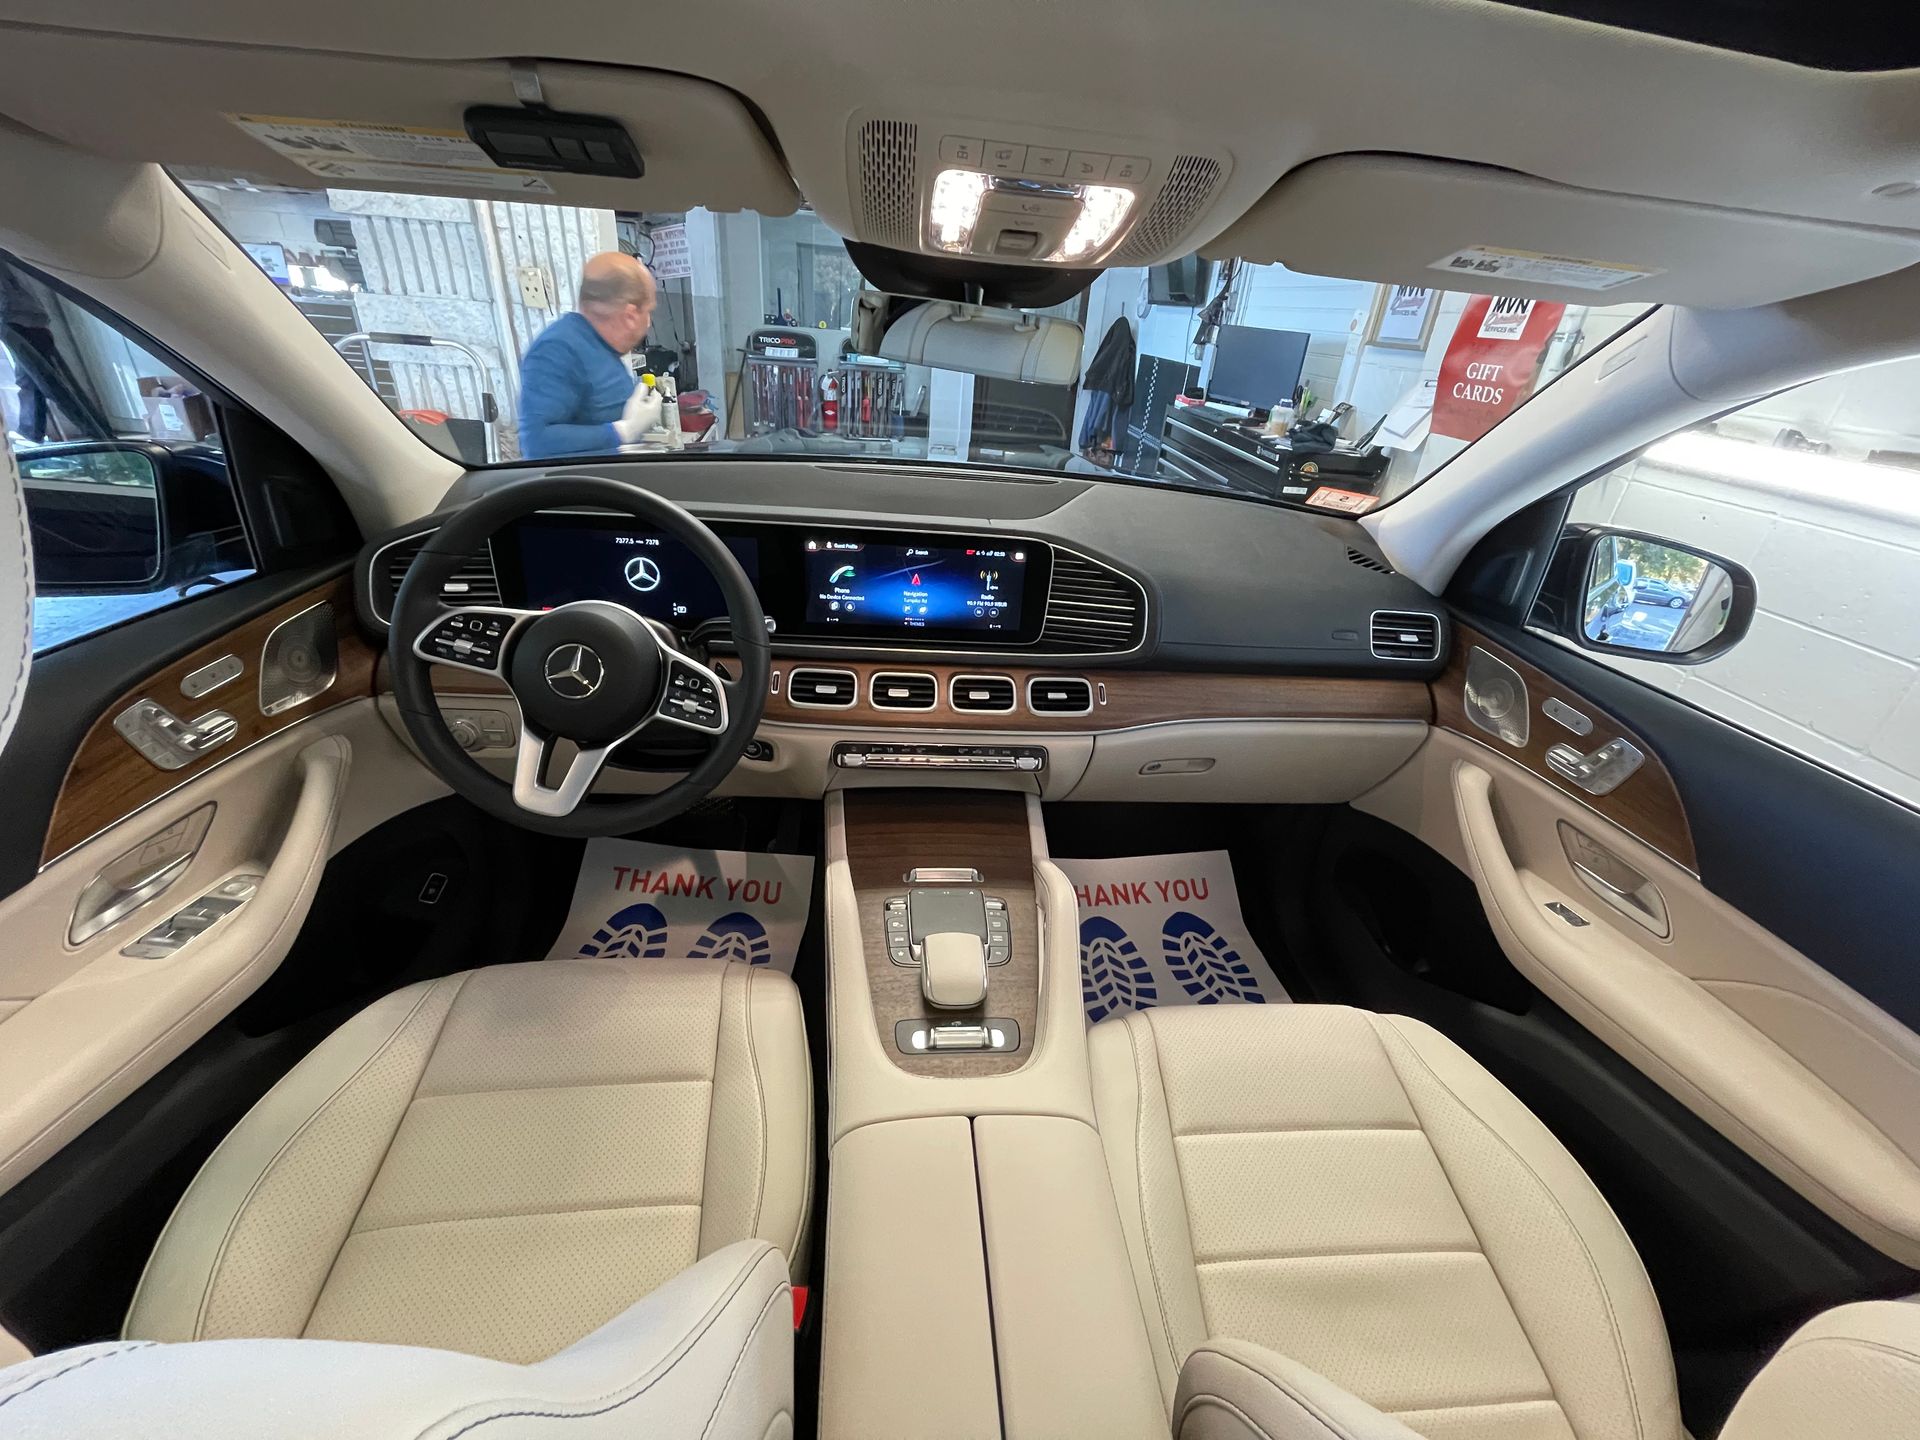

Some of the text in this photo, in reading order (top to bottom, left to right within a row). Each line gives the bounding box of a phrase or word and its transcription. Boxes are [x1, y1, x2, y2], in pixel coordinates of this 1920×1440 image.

[1492, 296, 1531, 314] MVN
[1466, 362, 1503, 381] GIFT
[1452, 382, 1504, 405] CARDS
[613, 866, 782, 904] THANK YOU
[1073, 877, 1209, 907] HANK YOU
